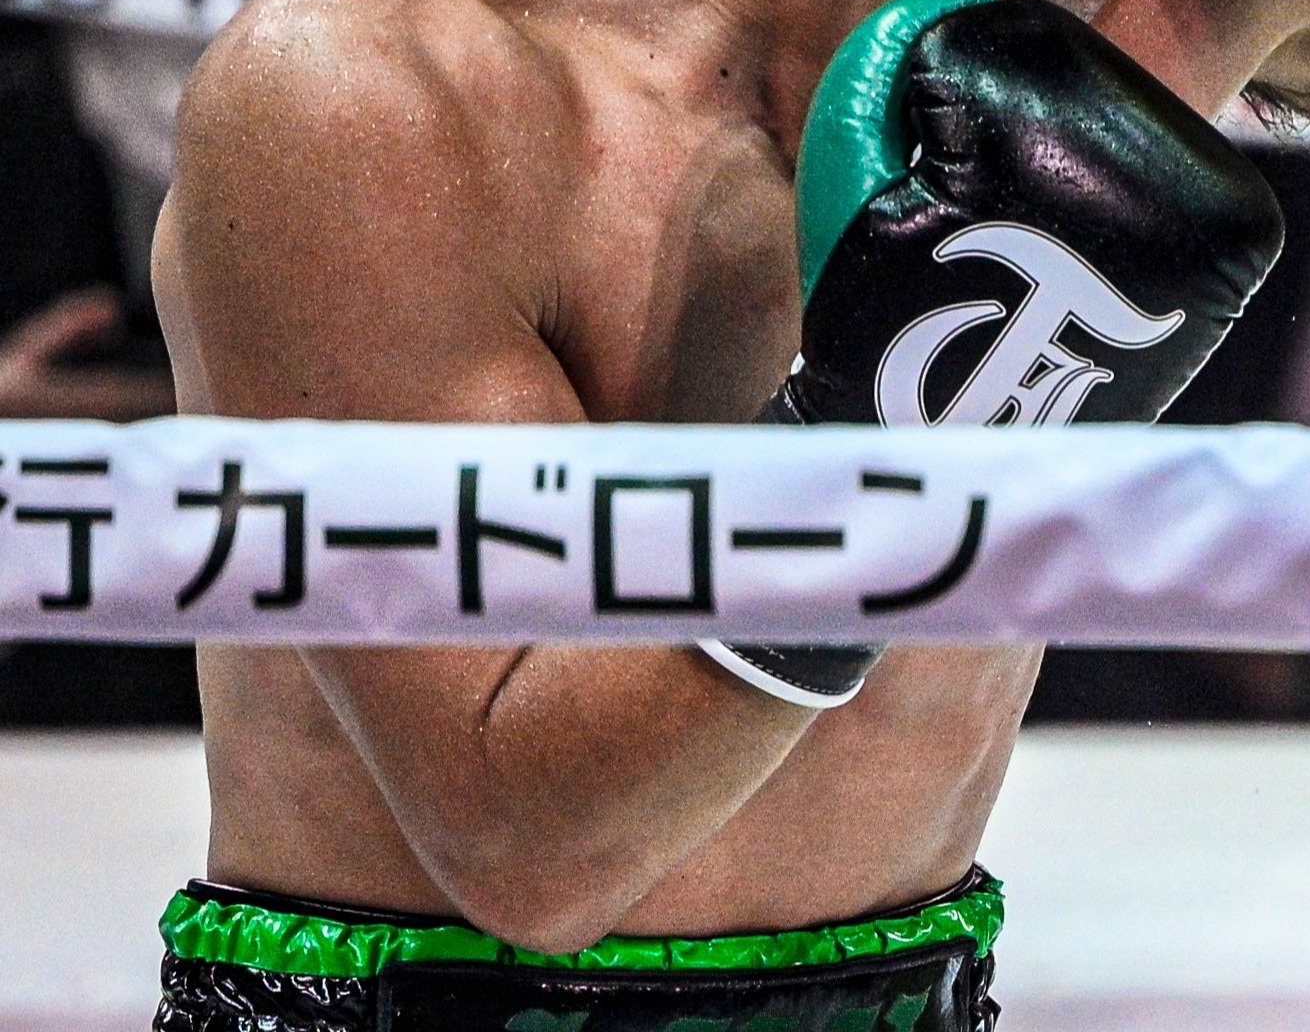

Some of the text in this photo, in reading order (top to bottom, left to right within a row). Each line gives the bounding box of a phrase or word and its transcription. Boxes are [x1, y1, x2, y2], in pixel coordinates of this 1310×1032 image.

[175, 458, 988, 616] カードローン
